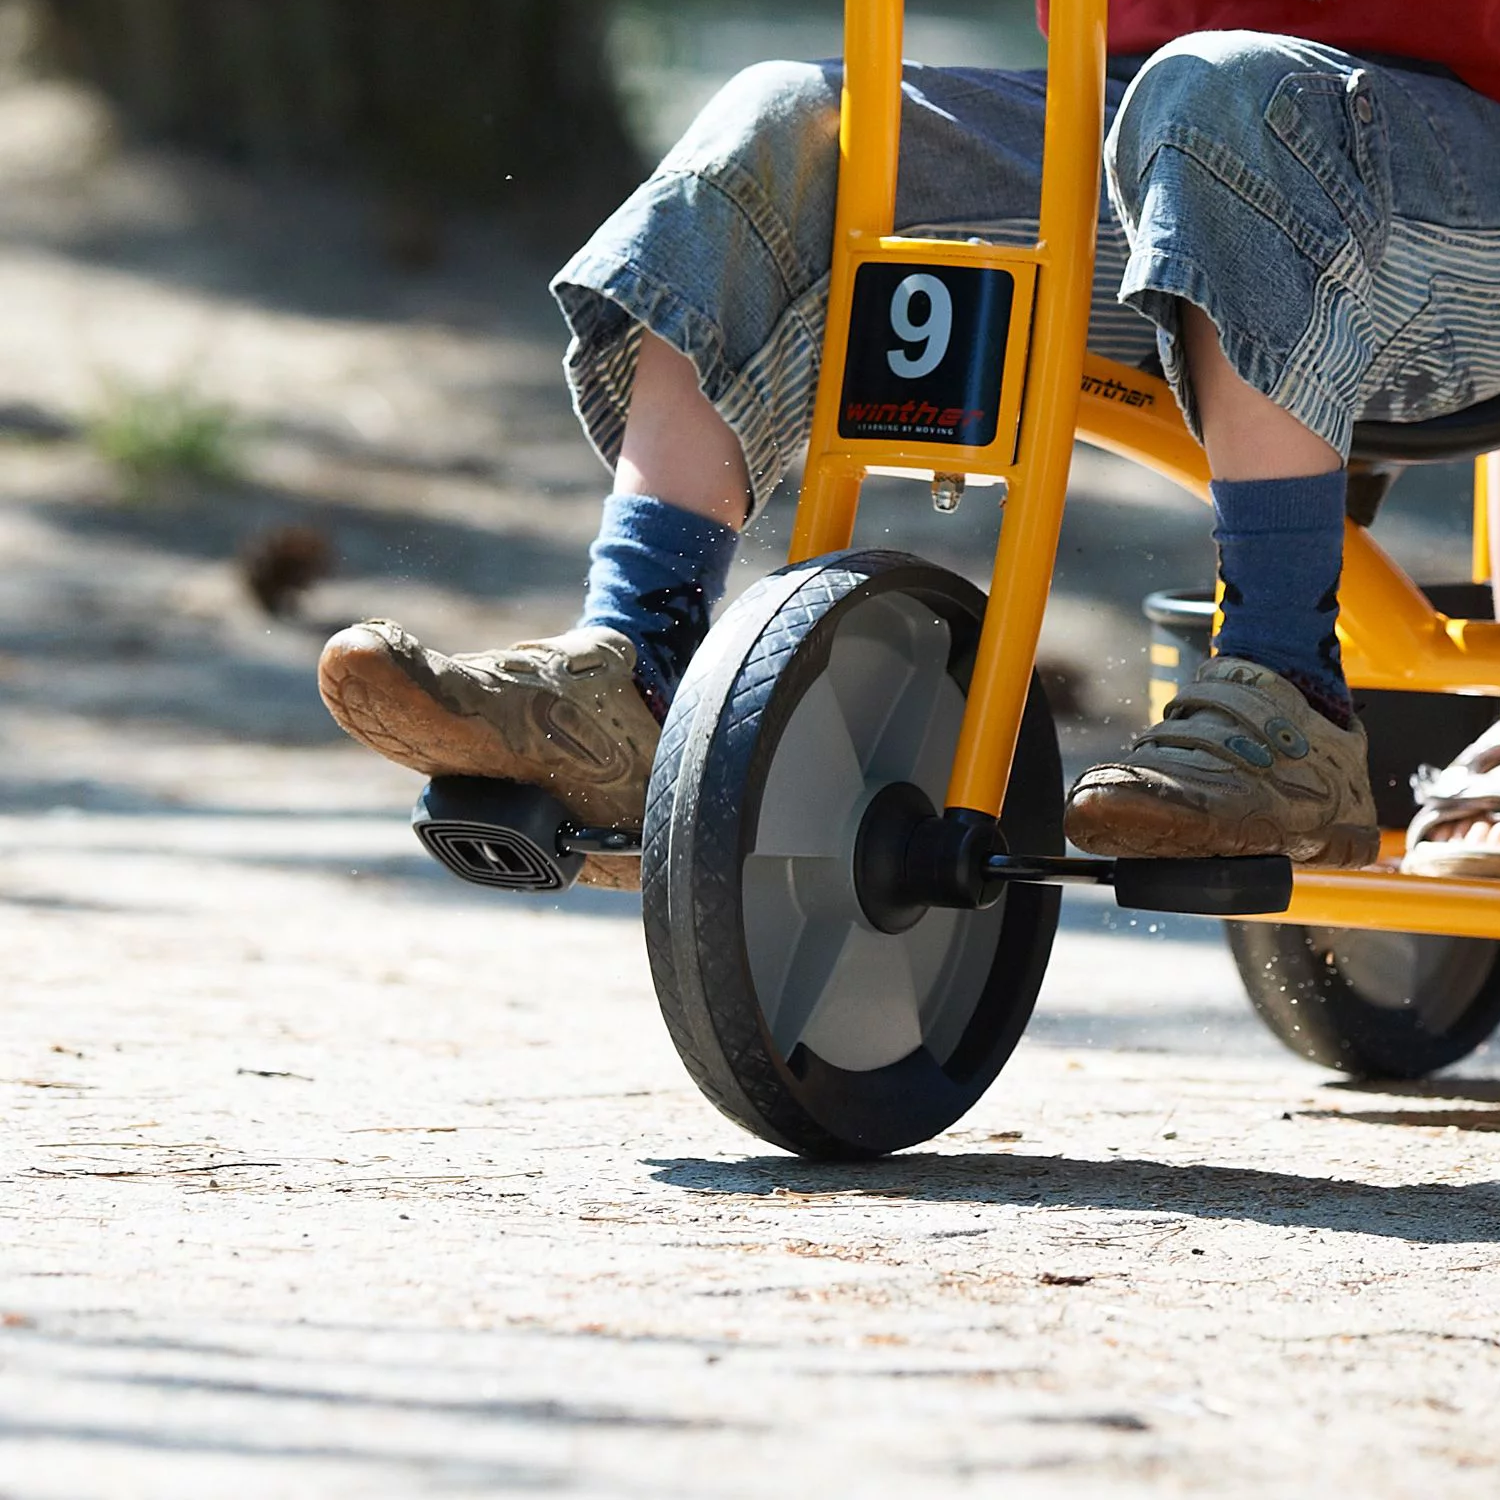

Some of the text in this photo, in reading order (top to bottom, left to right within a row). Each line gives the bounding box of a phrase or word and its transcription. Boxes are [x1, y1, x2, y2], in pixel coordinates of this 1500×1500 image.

[886, 273, 953, 379] 9
[847, 401, 985, 428] winther
[901, 425, 912, 433] BY
[915, 425, 954, 436] MOVING
